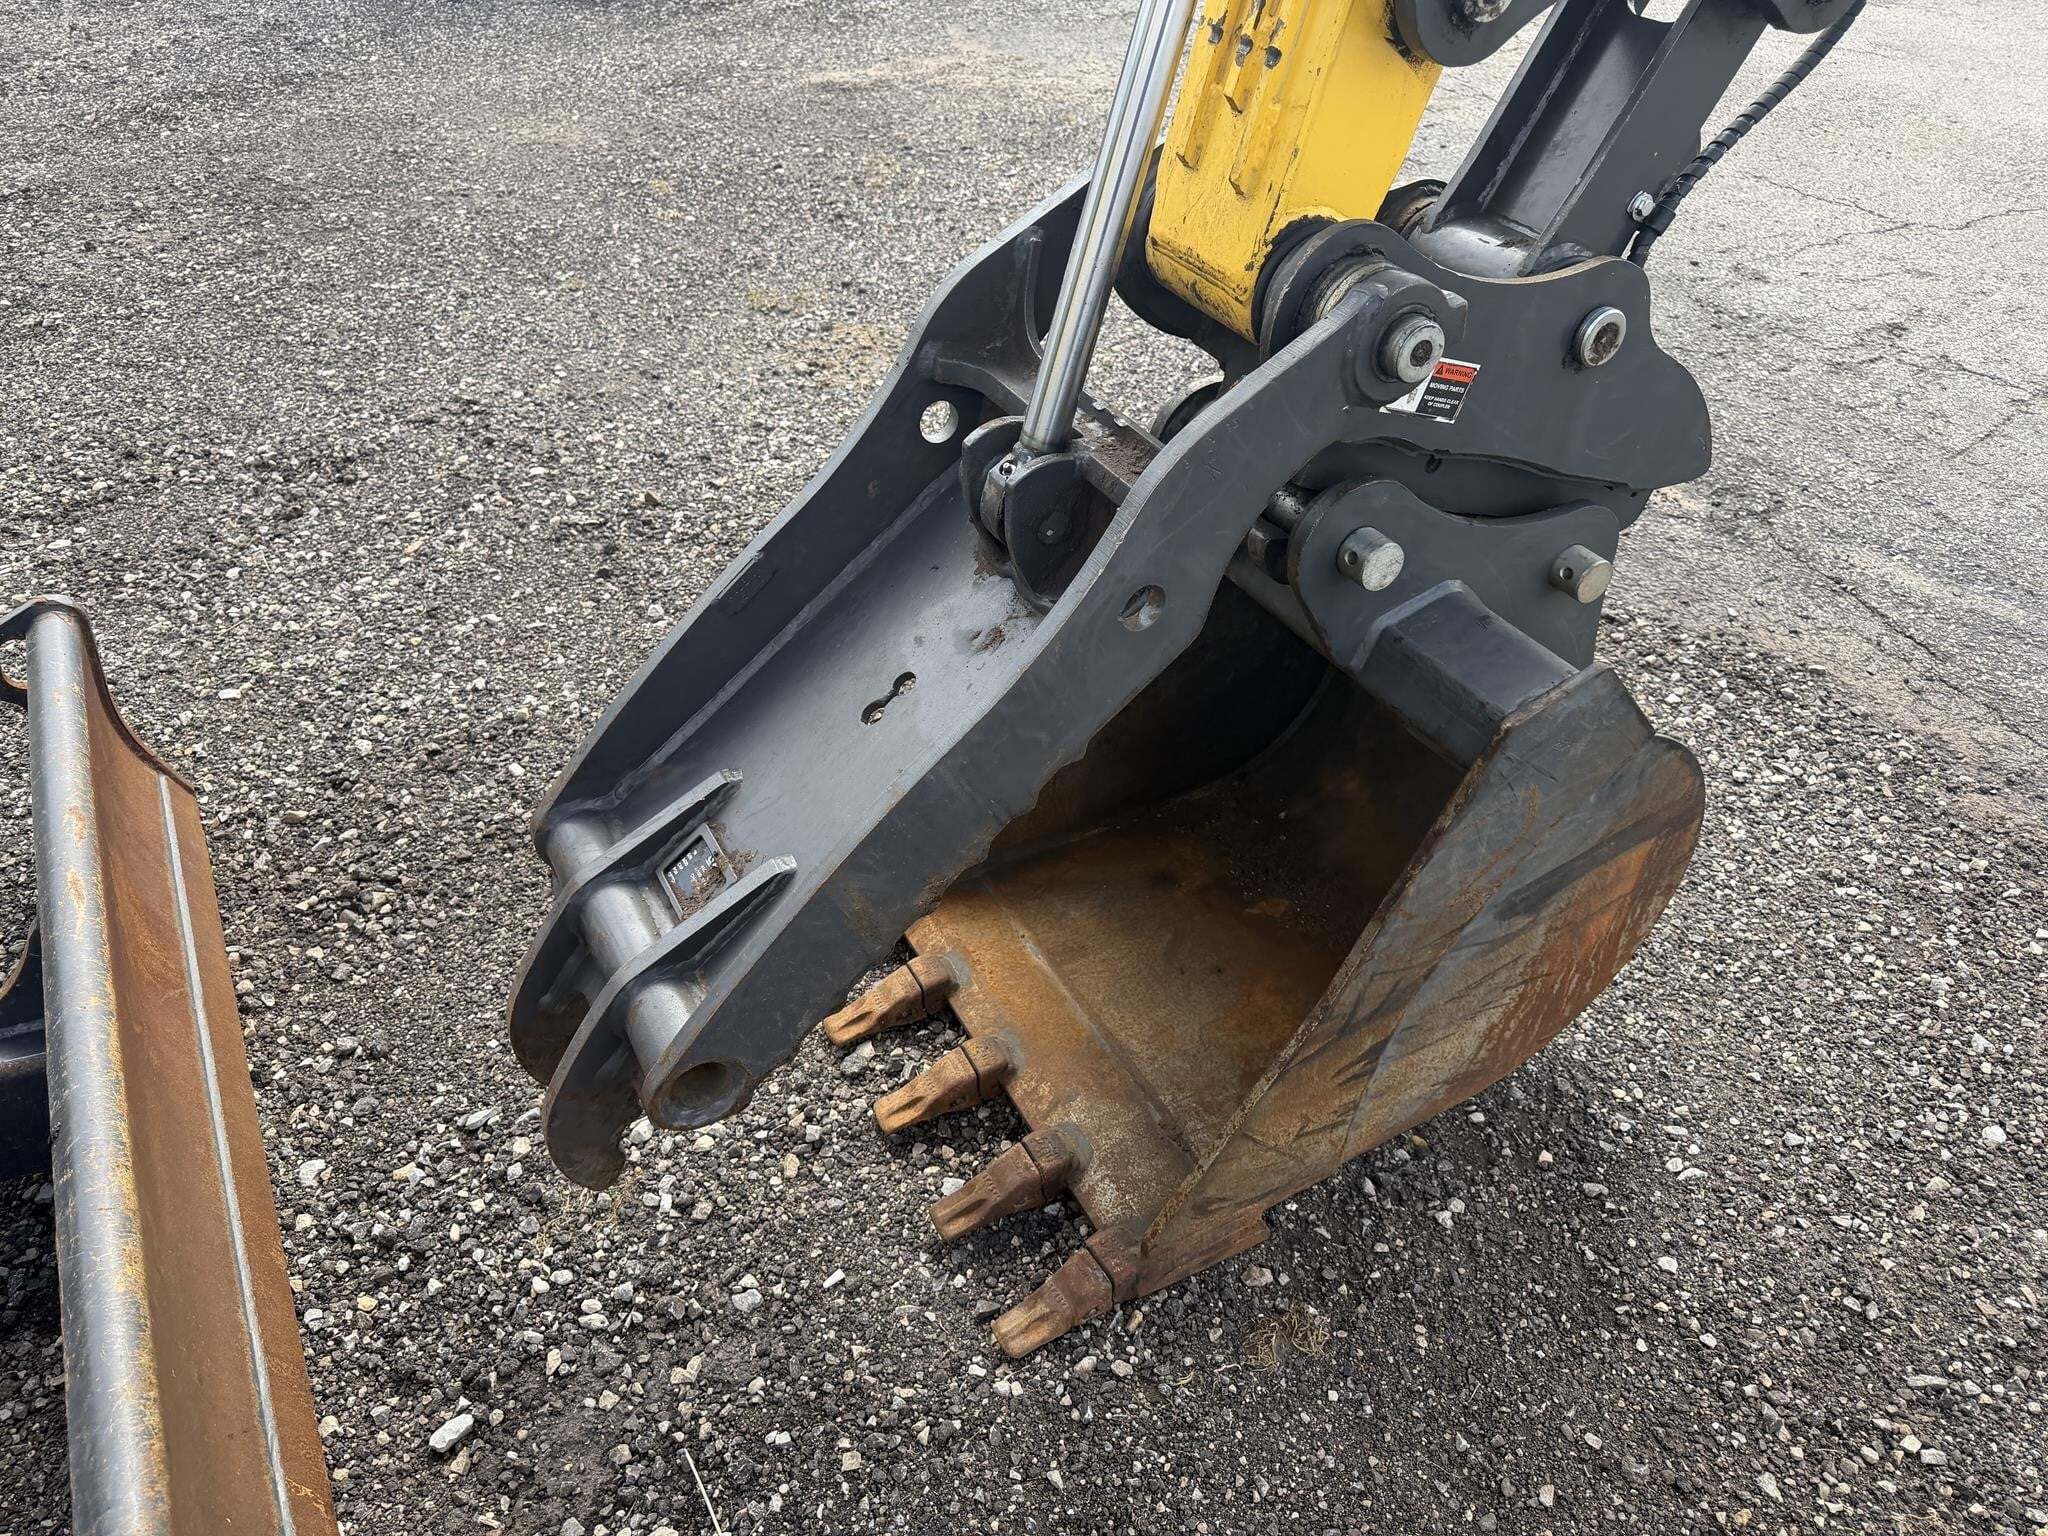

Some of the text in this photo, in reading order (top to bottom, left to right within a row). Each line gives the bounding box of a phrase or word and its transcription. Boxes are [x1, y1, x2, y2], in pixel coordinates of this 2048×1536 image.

[1444, 367, 1473, 379] WARNING
[1429, 382, 1465, 393] MOVING PARTS
